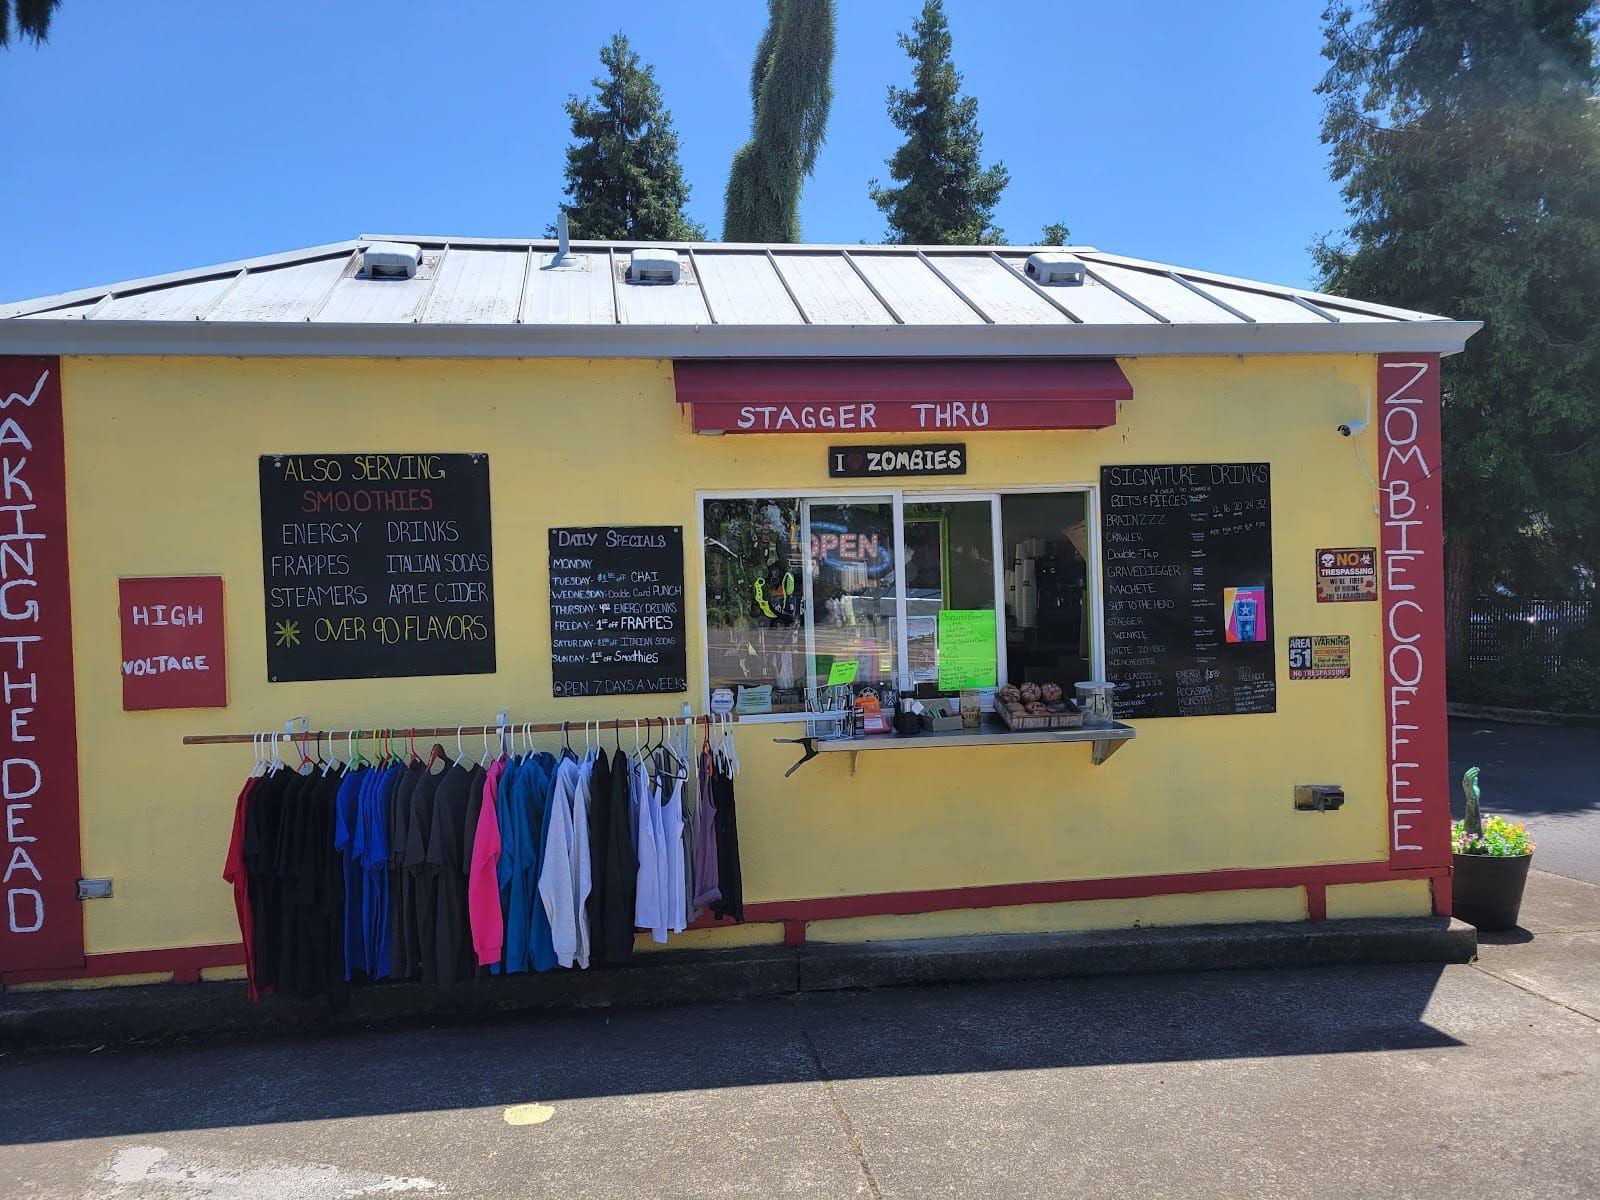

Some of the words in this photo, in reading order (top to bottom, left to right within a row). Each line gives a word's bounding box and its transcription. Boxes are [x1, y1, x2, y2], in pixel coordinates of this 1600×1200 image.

[737, 403, 877, 429] STAGGER
[911, 401, 989, 427] THRU
[284, 458, 342, 482] ALSO
[351, 455, 446, 480] SERVING
[834, 453, 846, 472] I
[866, 449, 962, 472] ZOMBIES
[1110, 465, 1199, 486] SIGNATURE
[1210, 464, 1268, 485] DRINKS
[1382, 362, 1430, 591] ZOMBIE
[302, 488, 433, 512] SMOOTHIES
[1110, 494, 1142, 507] BITS
[1150, 494, 1188, 507] PIECES
[1212, 504, 1220, 513] 12
[1223, 503, 1231, 513] 16
[1233, 501, 1243, 511] 20
[1245, 499, 1254, 510] 24
[1106, 513, 1166, 527] BRAINZZZ
[282, 522, 362, 545] ENERGY
[387, 520, 459, 543] DRINKS
[605, 529, 667, 548] SPECIALS
[1106, 532, 1143, 542] CRAWLER
[271, 555, 350, 577] FRAPPES
[385, 554, 441, 574] ITALIAN
[443, 553, 490, 573] SODAS
[552, 558, 593, 569] MONDAY
[1336, 552, 1359, 566] NO
[630, 571, 660, 583] CHAI
[1107, 564, 1181, 578] GRAVEDIGGER
[1320, 568, 1373, 576] TRESPASSING
[271, 585, 368, 608] STEAMERS
[388, 583, 430, 605] APPLE
[434, 582, 489, 603] CIDER
[633, 587, 651, 598] Card
[652, 585, 682, 598] PUNCH
[1109, 582, 1157, 594] MACHETE
[132, 604, 203, 627] HIGH
[613, 602, 643, 614] ENERGY
[645, 602, 677, 614] DRINKS
[314, 616, 366, 642] OVER
[372, 616, 400, 645] 90
[404, 614, 488, 641] FLAVORS
[620, 616, 673, 631] FRAPPES
[1289, 638, 1311, 648] AREA
[1313, 637, 1349, 646] WARNING
[122, 655, 209, 676] VOLTAGE
[1289, 648, 1312, 668] 51
[0, 635, 44, 742] THE
[554, 680, 589, 696] OPEN
[593, 680, 603, 695] 7
[605, 678, 634, 693] DAYS
[634, 680, 645, 692] A
[1388, 599, 1424, 851] COFFEE
[2, 758, 44, 933] DEAD
